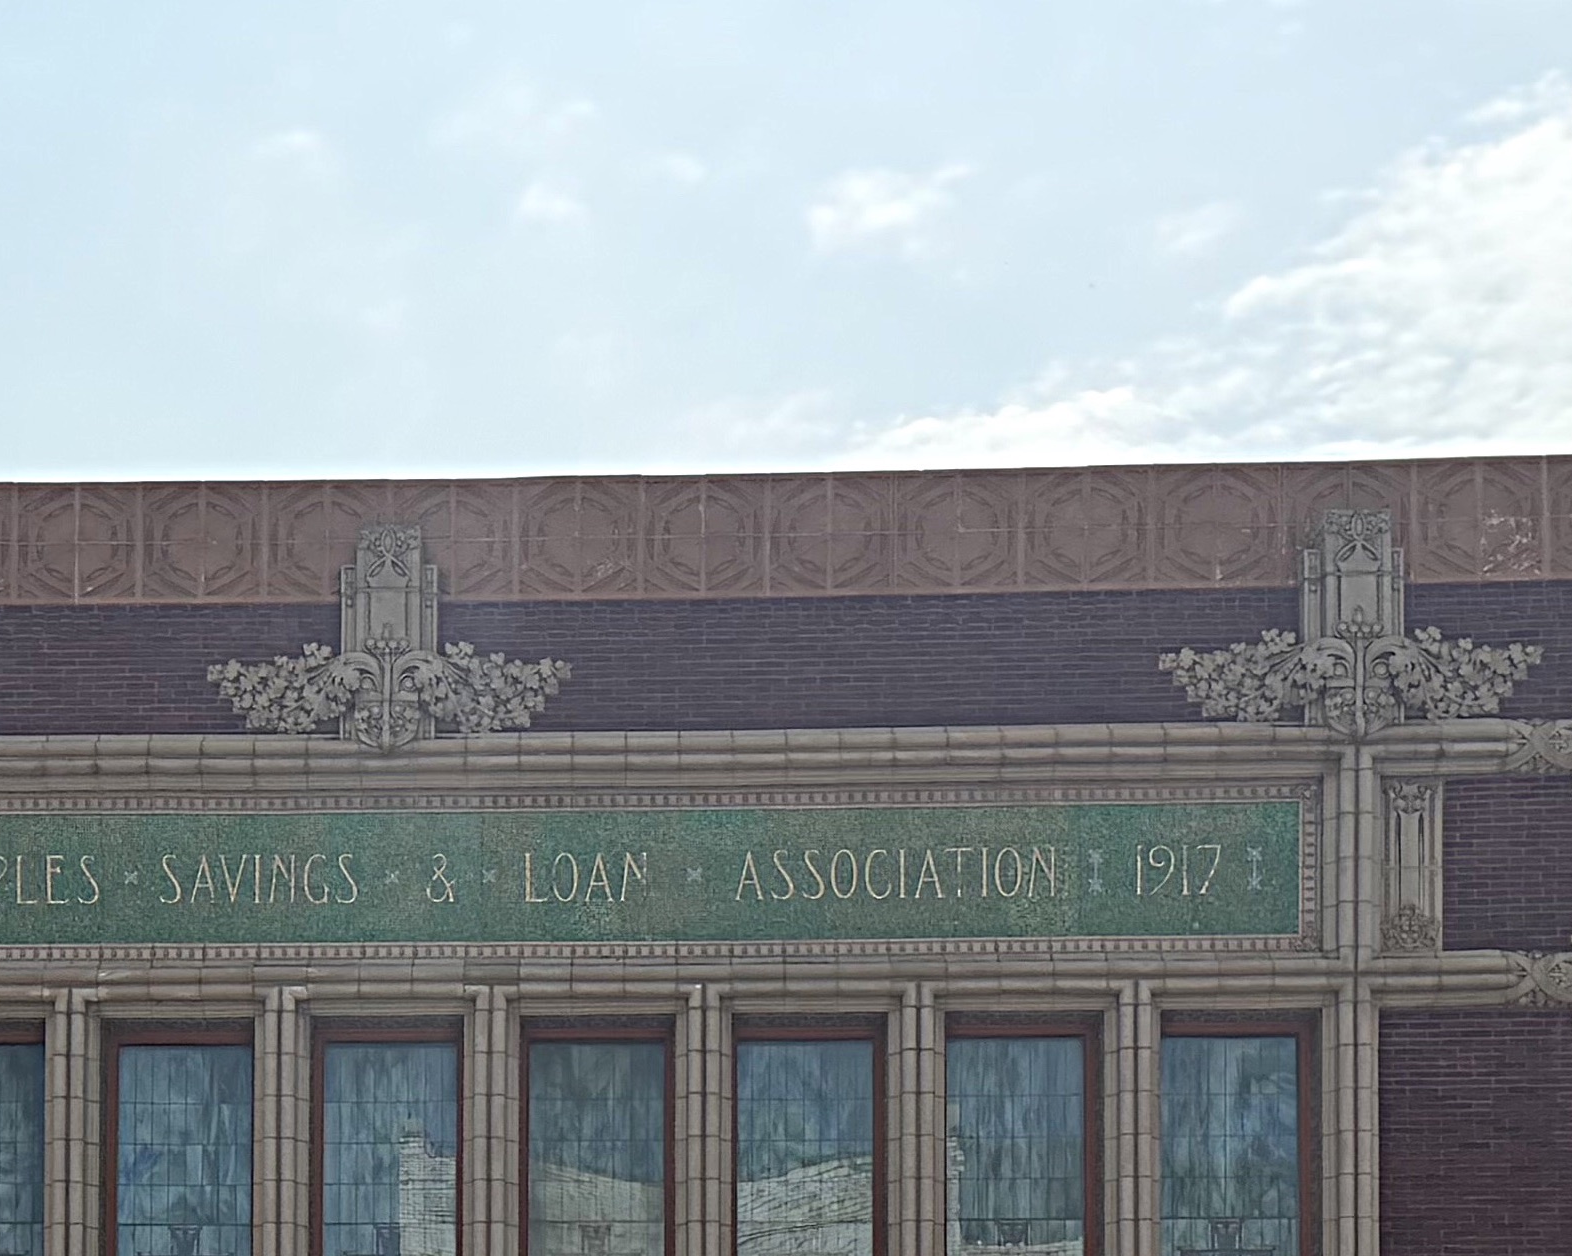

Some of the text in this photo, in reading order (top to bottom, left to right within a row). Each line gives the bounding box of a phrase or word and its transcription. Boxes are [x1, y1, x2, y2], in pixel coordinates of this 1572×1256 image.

[159, 852, 361, 905] SAVINGS
[425, 851, 457, 904] &
[522, 850, 649, 904] LOAN
[733, 844, 1059, 902] ASSOCIATION
[1133, 842, 1223, 898] 1917
